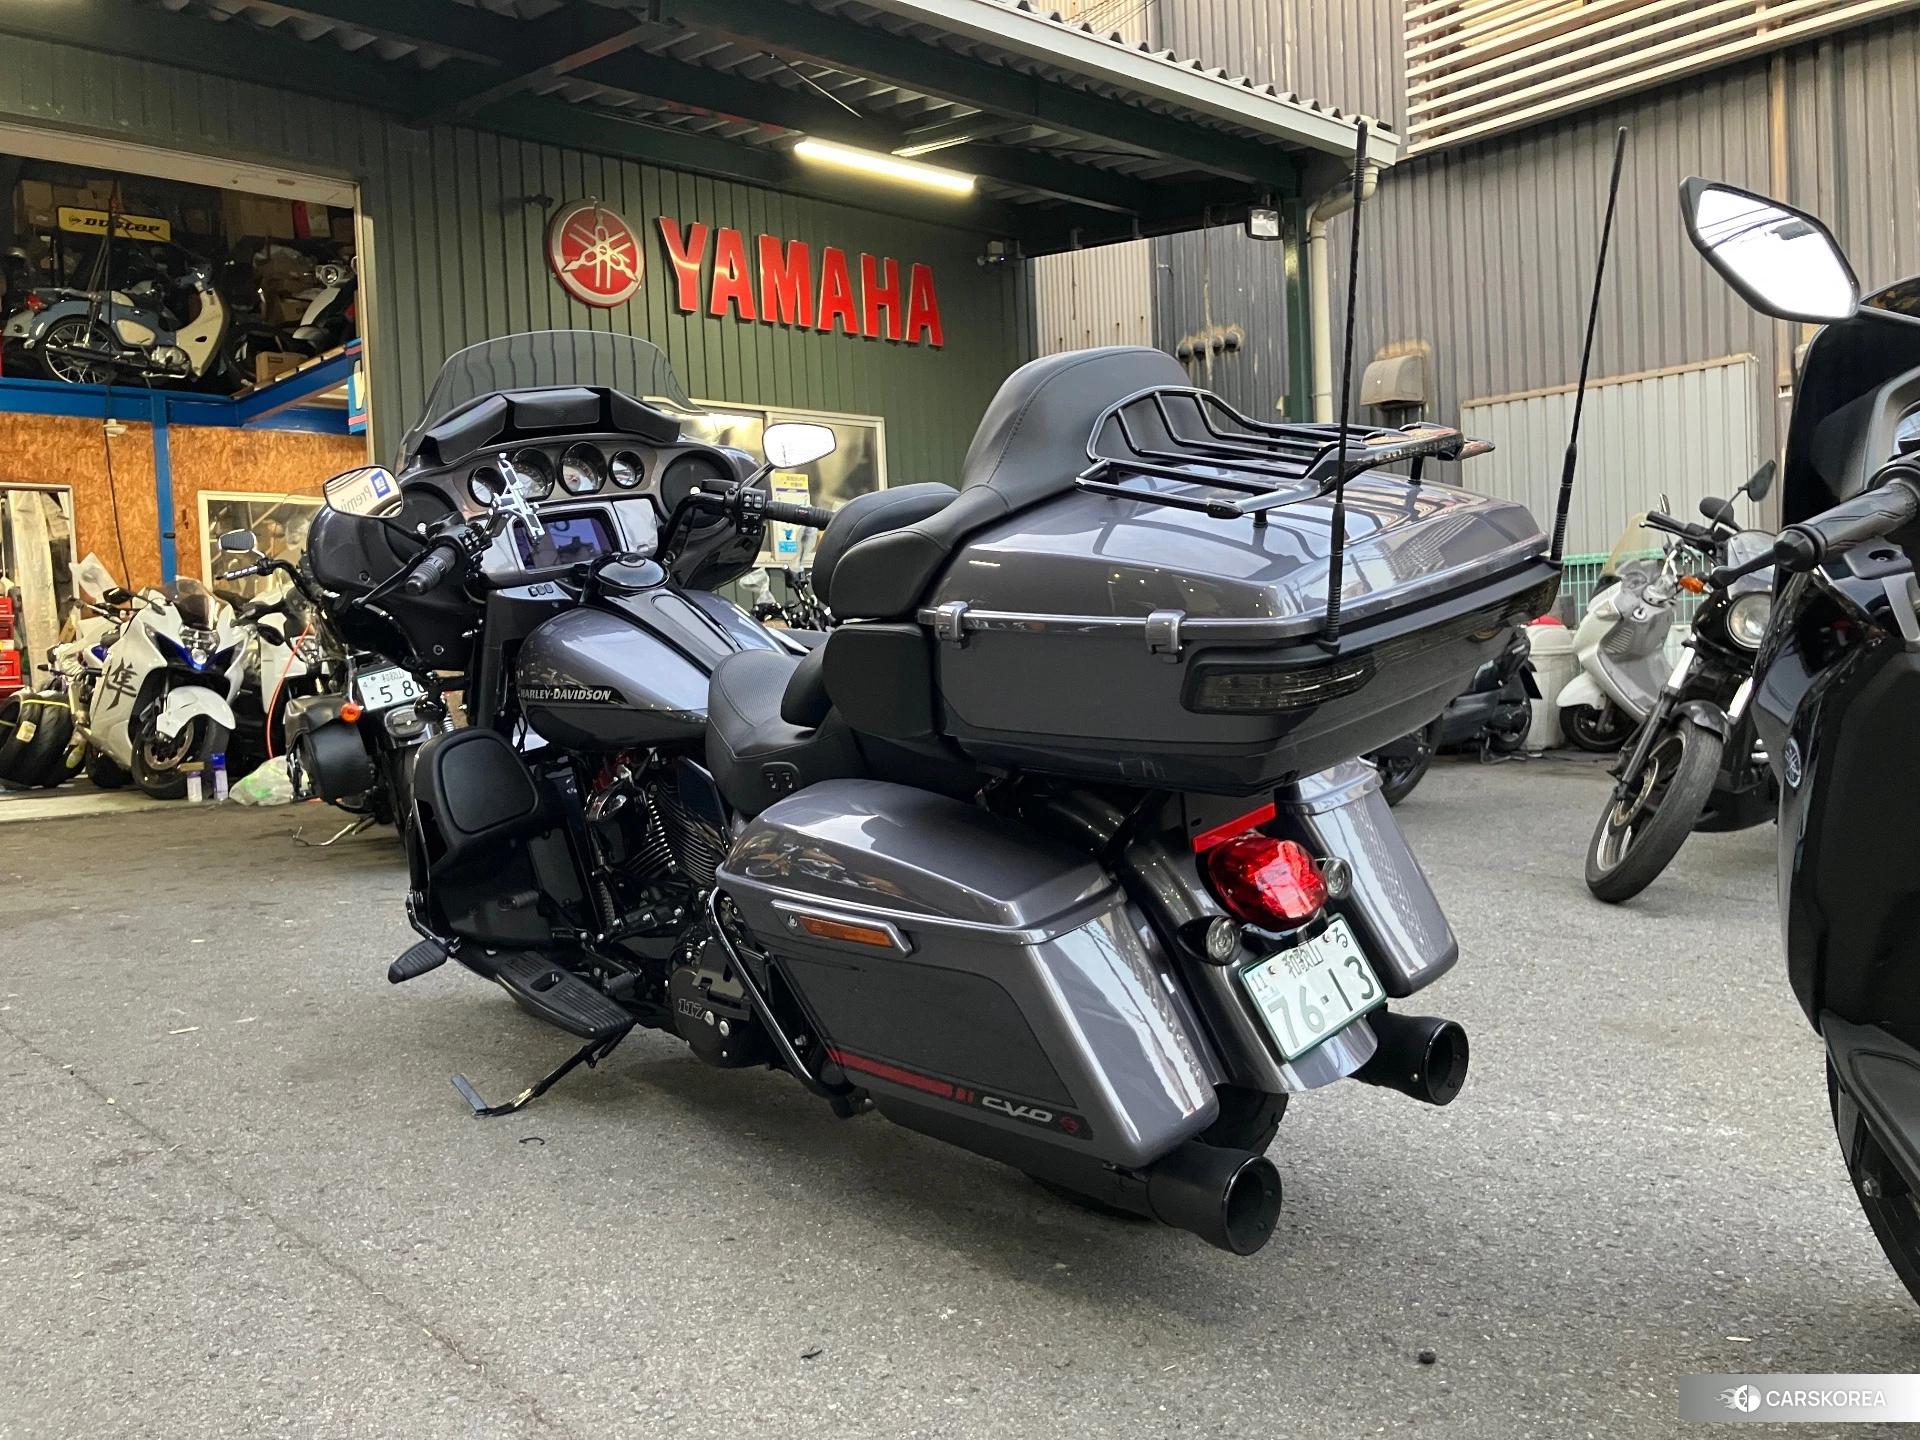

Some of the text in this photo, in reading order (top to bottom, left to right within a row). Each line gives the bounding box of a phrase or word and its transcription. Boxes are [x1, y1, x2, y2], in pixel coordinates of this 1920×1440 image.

[83, 217, 160, 232] DULOP
[658, 216, 944, 346] YAMAHA
[105, 656, 138, 711] 隼
[520, 687, 612, 701] HARLEY-DAVIDSON
[1282, 926, 1349, 978] 和歌山 る
[678, 998, 706, 1020] 117
[982, 1096, 1053, 1123] CVO
